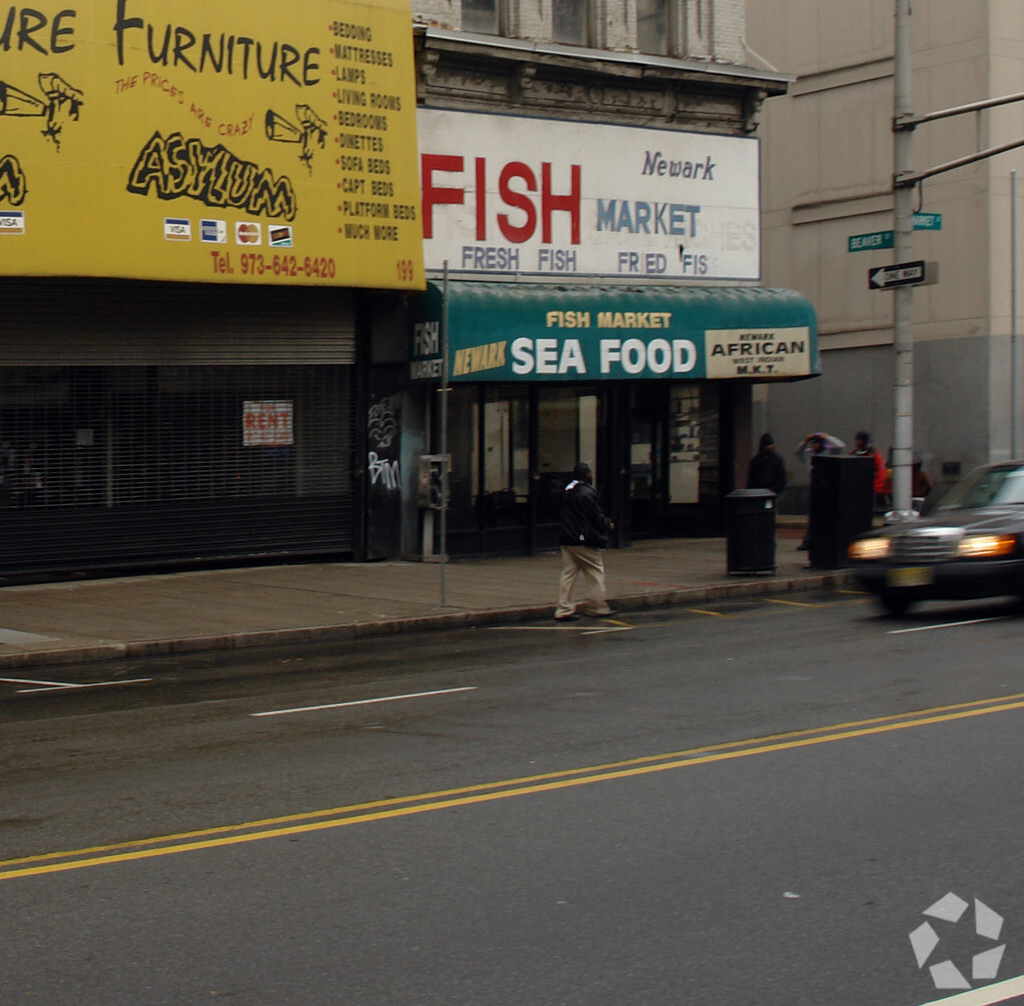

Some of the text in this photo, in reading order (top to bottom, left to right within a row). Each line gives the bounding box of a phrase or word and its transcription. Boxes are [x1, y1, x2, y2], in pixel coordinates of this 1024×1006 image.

[333, 21, 372, 42] BEDDING
[334, 43, 393, 67] MATTRESSES
[336, 65, 366, 85] LAMPS
[115, 71, 255, 137] THE PRICES ARE CRAZY
[337, 88, 401, 112] LIVING ROOMS
[338, 111, 387, 131] BEDROOMS
[339, 132, 383, 152] DINETTES
[126, 130, 298, 222] ASYLUM
[341, 155, 391, 175] SOFA BEDS
[641, 151, 716, 181] Newark
[343, 178, 394, 197] CAPT BEDS
[421, 153, 581, 245] FISH
[343, 201, 416, 221] PLATFORM BEDS
[596, 198, 701, 237] MARKET
[169, 225, 186, 234] VISA
[344, 223, 398, 241] MUCH MORE
[211, 251, 336, 278] Tel. 973-642-6420
[396, 259, 413, 281] 199
[462, 246, 519, 270] FRESH
[538, 249, 577, 272] FISH
[545, 310, 672, 329] FISH MARKET
[414, 321, 439, 355] FISH
[711, 341, 805, 356] AFRICAN
[452, 340, 507, 377] NEWARK
[510, 337, 697, 375] SEA FOOD
[245, 412, 289, 430] RENT
